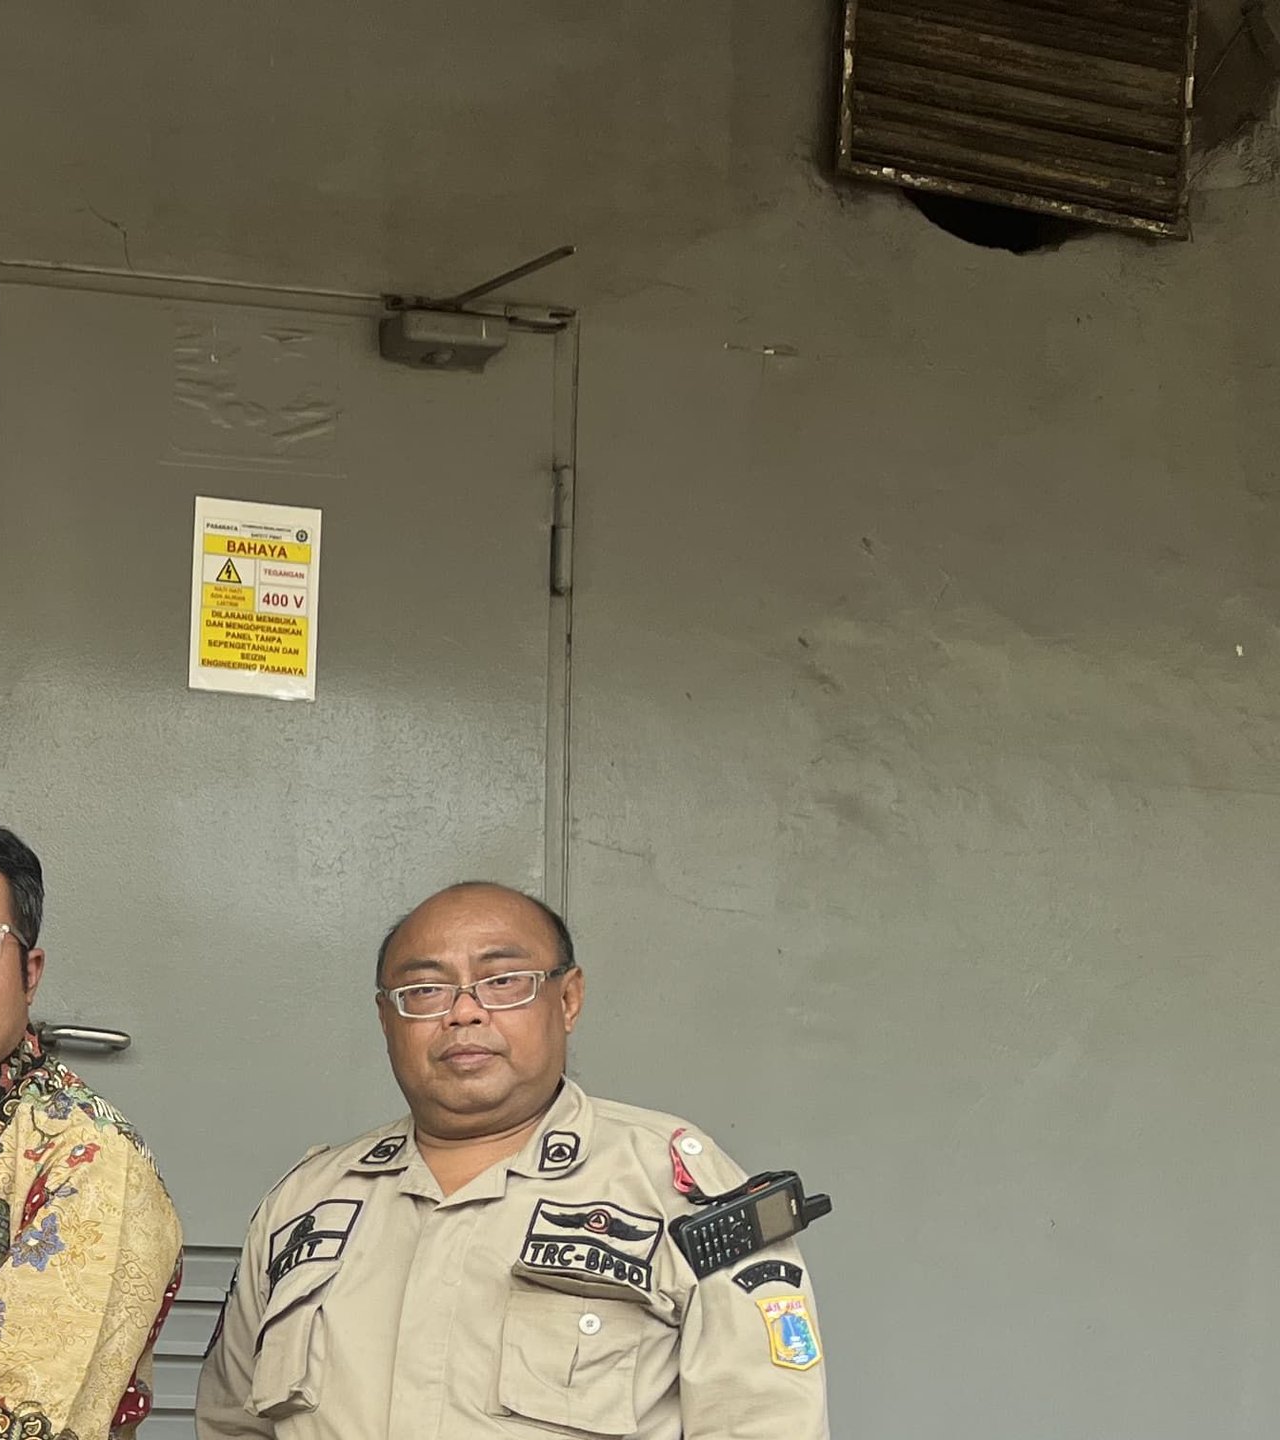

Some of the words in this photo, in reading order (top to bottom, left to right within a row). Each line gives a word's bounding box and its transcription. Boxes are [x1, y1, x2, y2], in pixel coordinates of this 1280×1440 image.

[227, 540, 288, 559] BAHAYA
[262, 592, 289, 607] 400
[293, 594, 304, 609] V
[530, 1243, 644, 1284] TRC-BPBD
